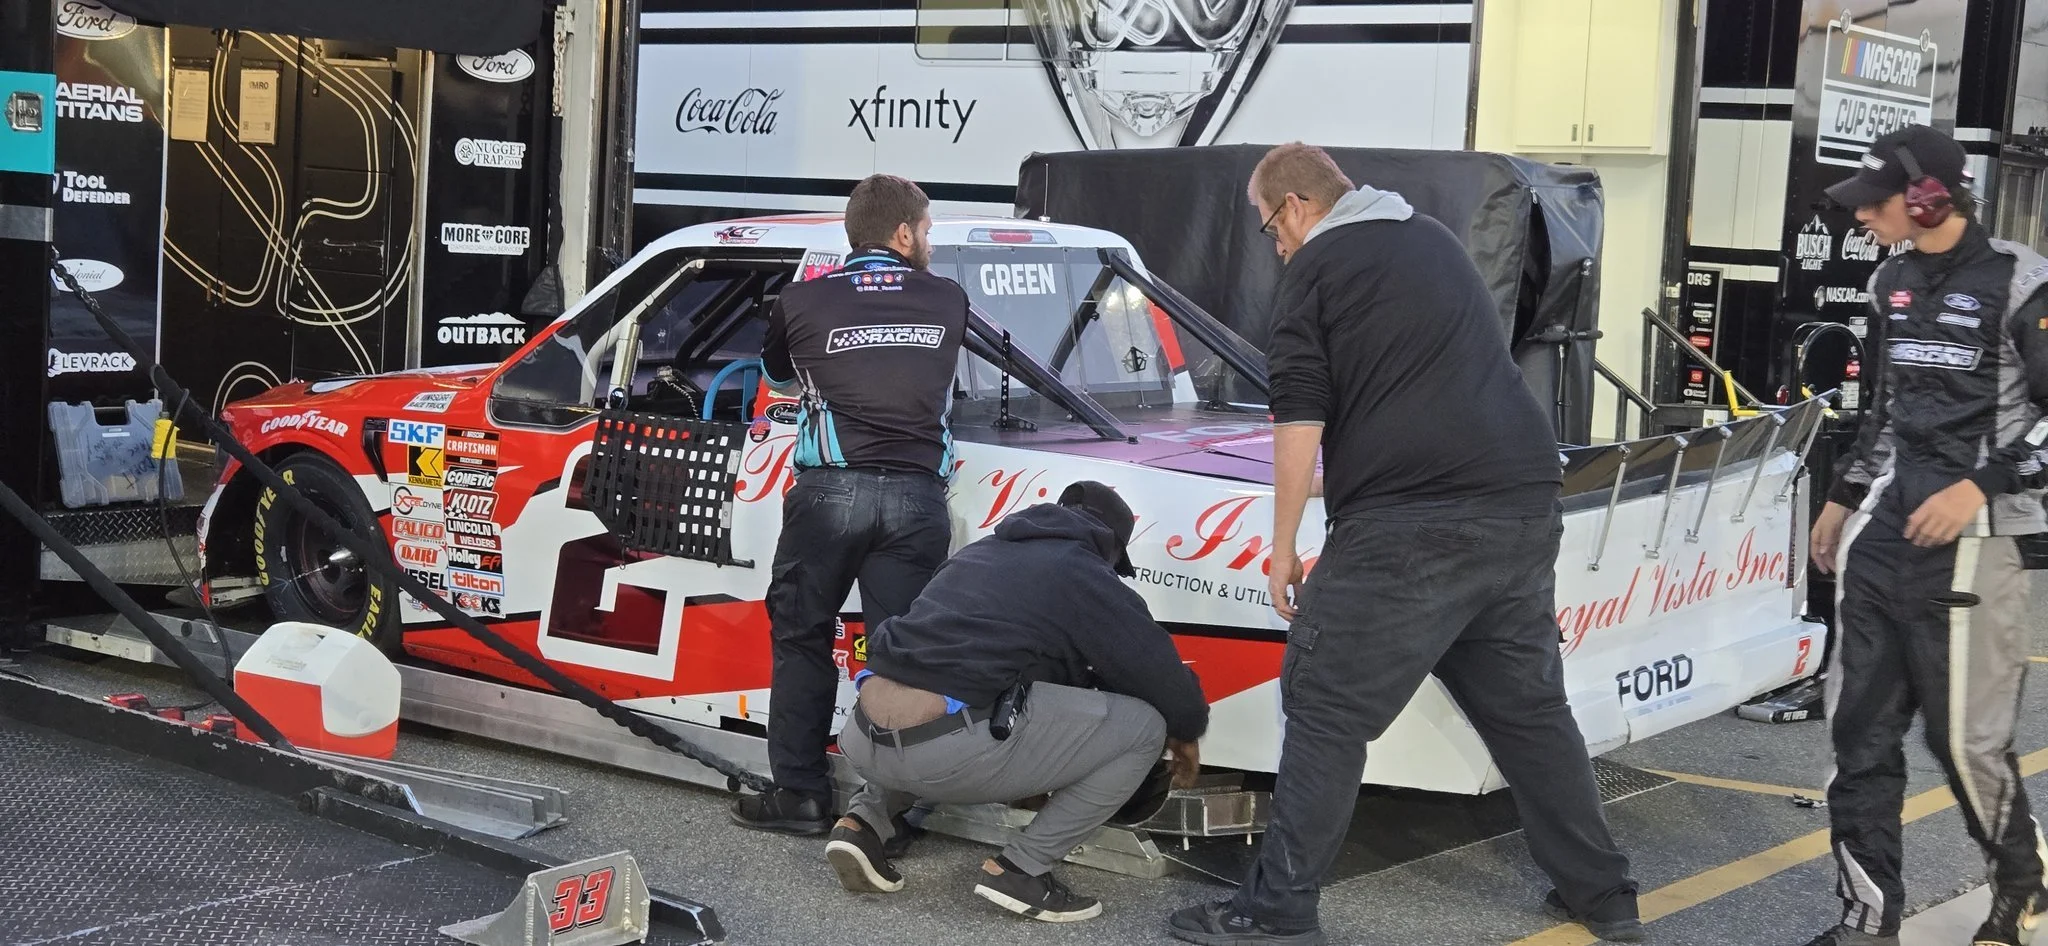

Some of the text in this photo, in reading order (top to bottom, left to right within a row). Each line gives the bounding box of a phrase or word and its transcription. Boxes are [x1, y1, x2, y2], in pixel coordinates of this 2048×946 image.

[57, 1, 117, 32] Ford
[1860, 41, 1922, 88] NASCAR
[55, 81, 144, 105] AERIAL
[55, 100, 144, 123] TITANS
[675, 87, 785, 136] Coca-Cola
[848, 85, 977, 144] xfinity
[1834, 98, 1867, 135] CUP
[474, 142, 525, 156] NUGGET
[444, 226, 528, 245] MORE CORE
[1795, 233, 1832, 260] BUSCH
[806, 253, 839, 267] BUILT
[979, 263, 1057, 296] GREEN
[437, 326, 527, 344] OUTBACK
[868, 333, 940, 345] RACING
[62, 356, 130, 369] LEVRACK
[261, 410, 348, 437] GOODYEAR
[390, 421, 443, 443] SKF
[446, 440, 497, 455] CRAFTSMAN
[408, 476, 442, 487] KENNAMETAL
[447, 470, 495, 488] COMETIC
[450, 493, 494, 515] KLOTZ
[254, 468, 296, 586] GOODYER
[394, 520, 444, 538] CALICO
[447, 519, 492, 536] LINCOLN
[460, 535, 496, 549] WELDERS
[401, 545, 439, 564] DART
[448, 547, 481, 569] Holley
[404, 567, 448, 590] ESEL
[452, 571, 501, 593] tilton
[1131, 565, 1275, 607] TRUCTION & UTIL
[1556, 565, 1641, 661] oyal
[1648, 551, 1722, 617] Vista
[1726, 526, 1785, 590] Inc.
[1791, 636, 1812, 677] 2
[1615, 653, 1693, 708] FORD
[550, 866, 616, 935] 33
